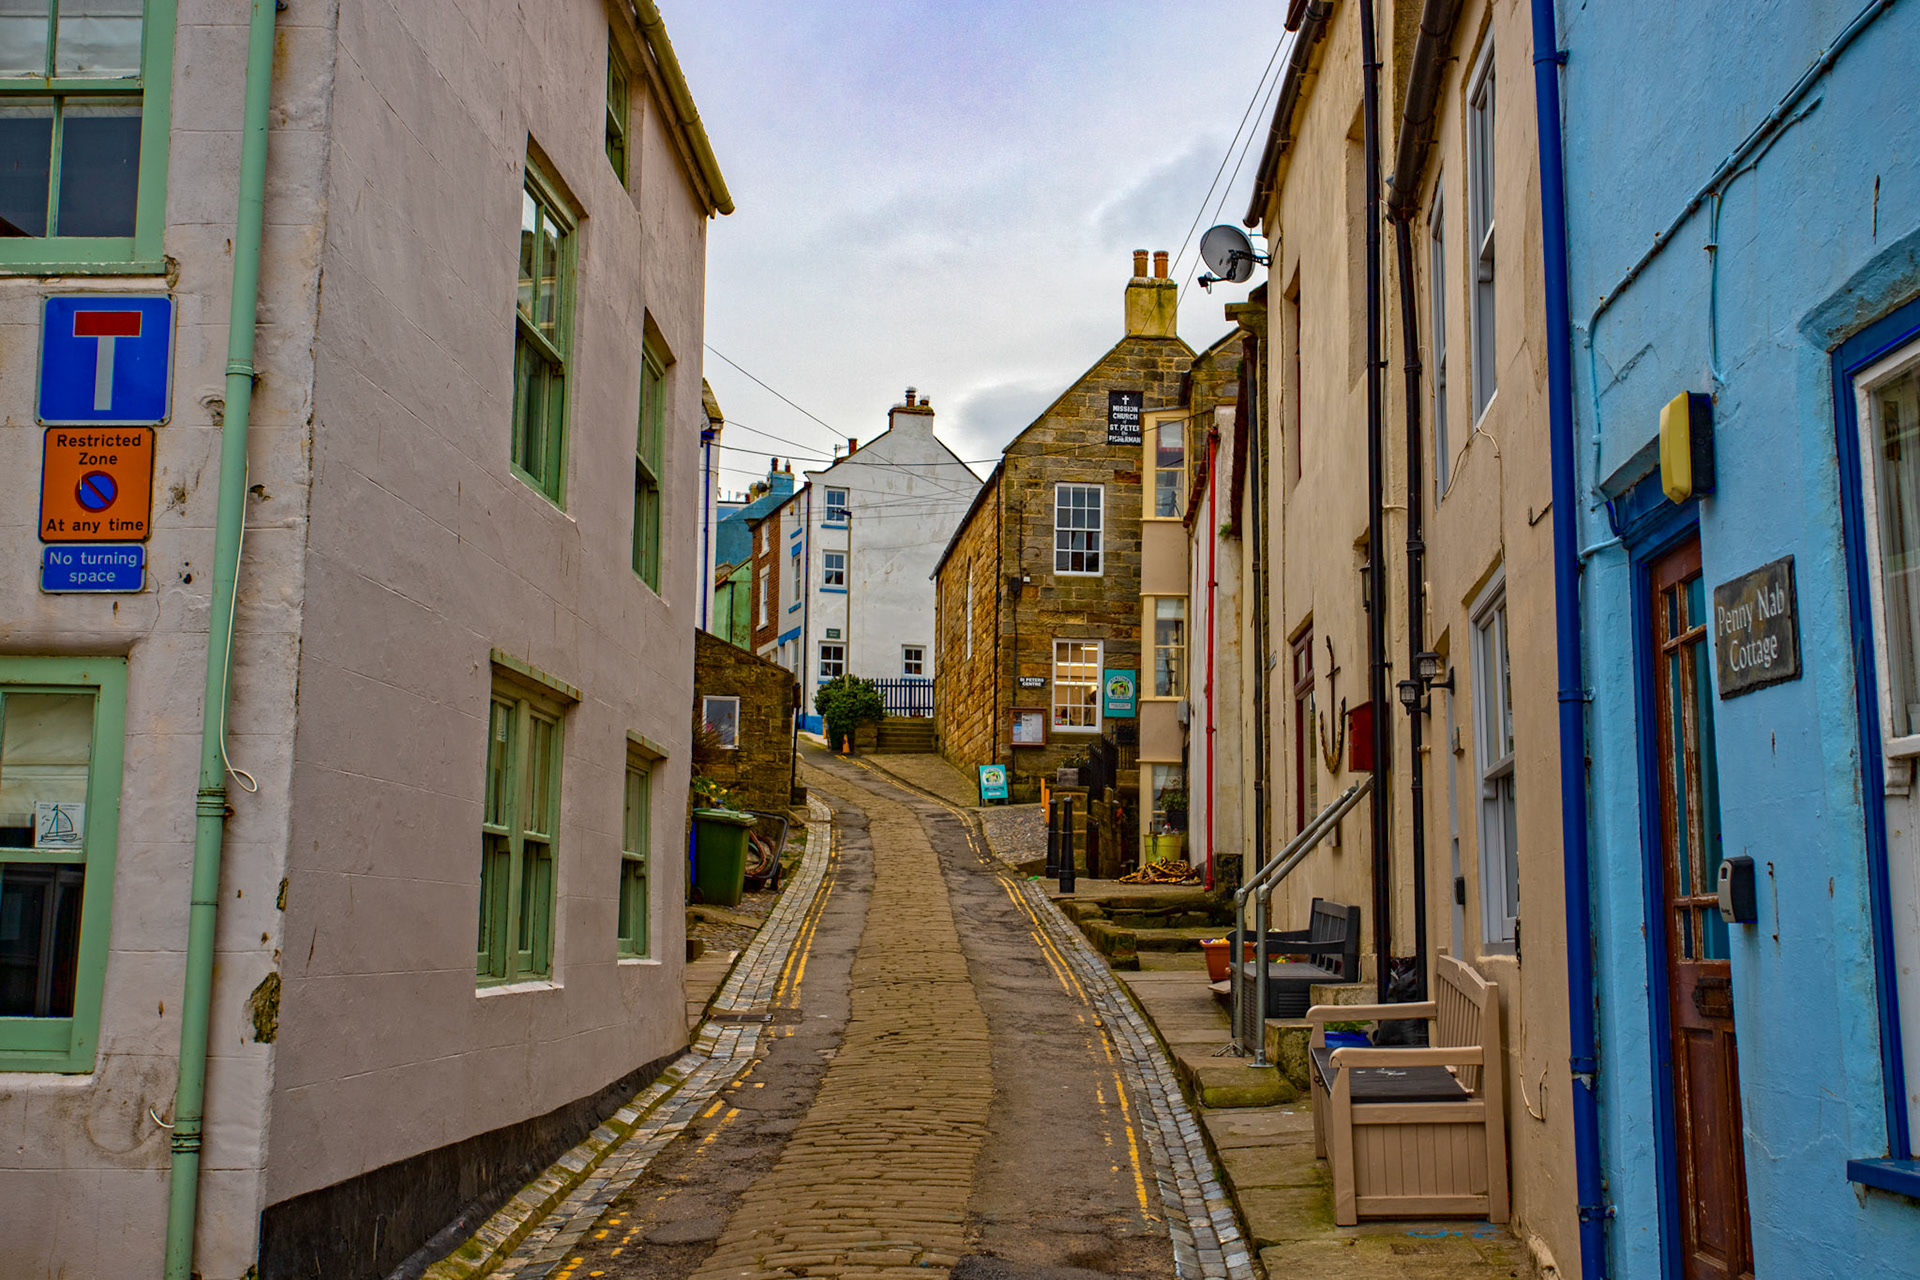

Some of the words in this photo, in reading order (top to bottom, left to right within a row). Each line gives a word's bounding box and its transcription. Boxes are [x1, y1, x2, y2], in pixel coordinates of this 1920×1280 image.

[56, 433, 142, 448] Restricted
[78, 452, 118, 465] Zone
[46, 518, 66, 532] At
[72, 520, 100, 534] any
[109, 518, 144, 531] time
[49, 552, 72, 565] No
[80, 552, 137, 567] turning
[69, 570, 116, 585] space
[1717, 601, 1753, 637] Penny
[1756, 581, 1785, 621] Nab
[1729, 634, 1778, 672] Cottage
